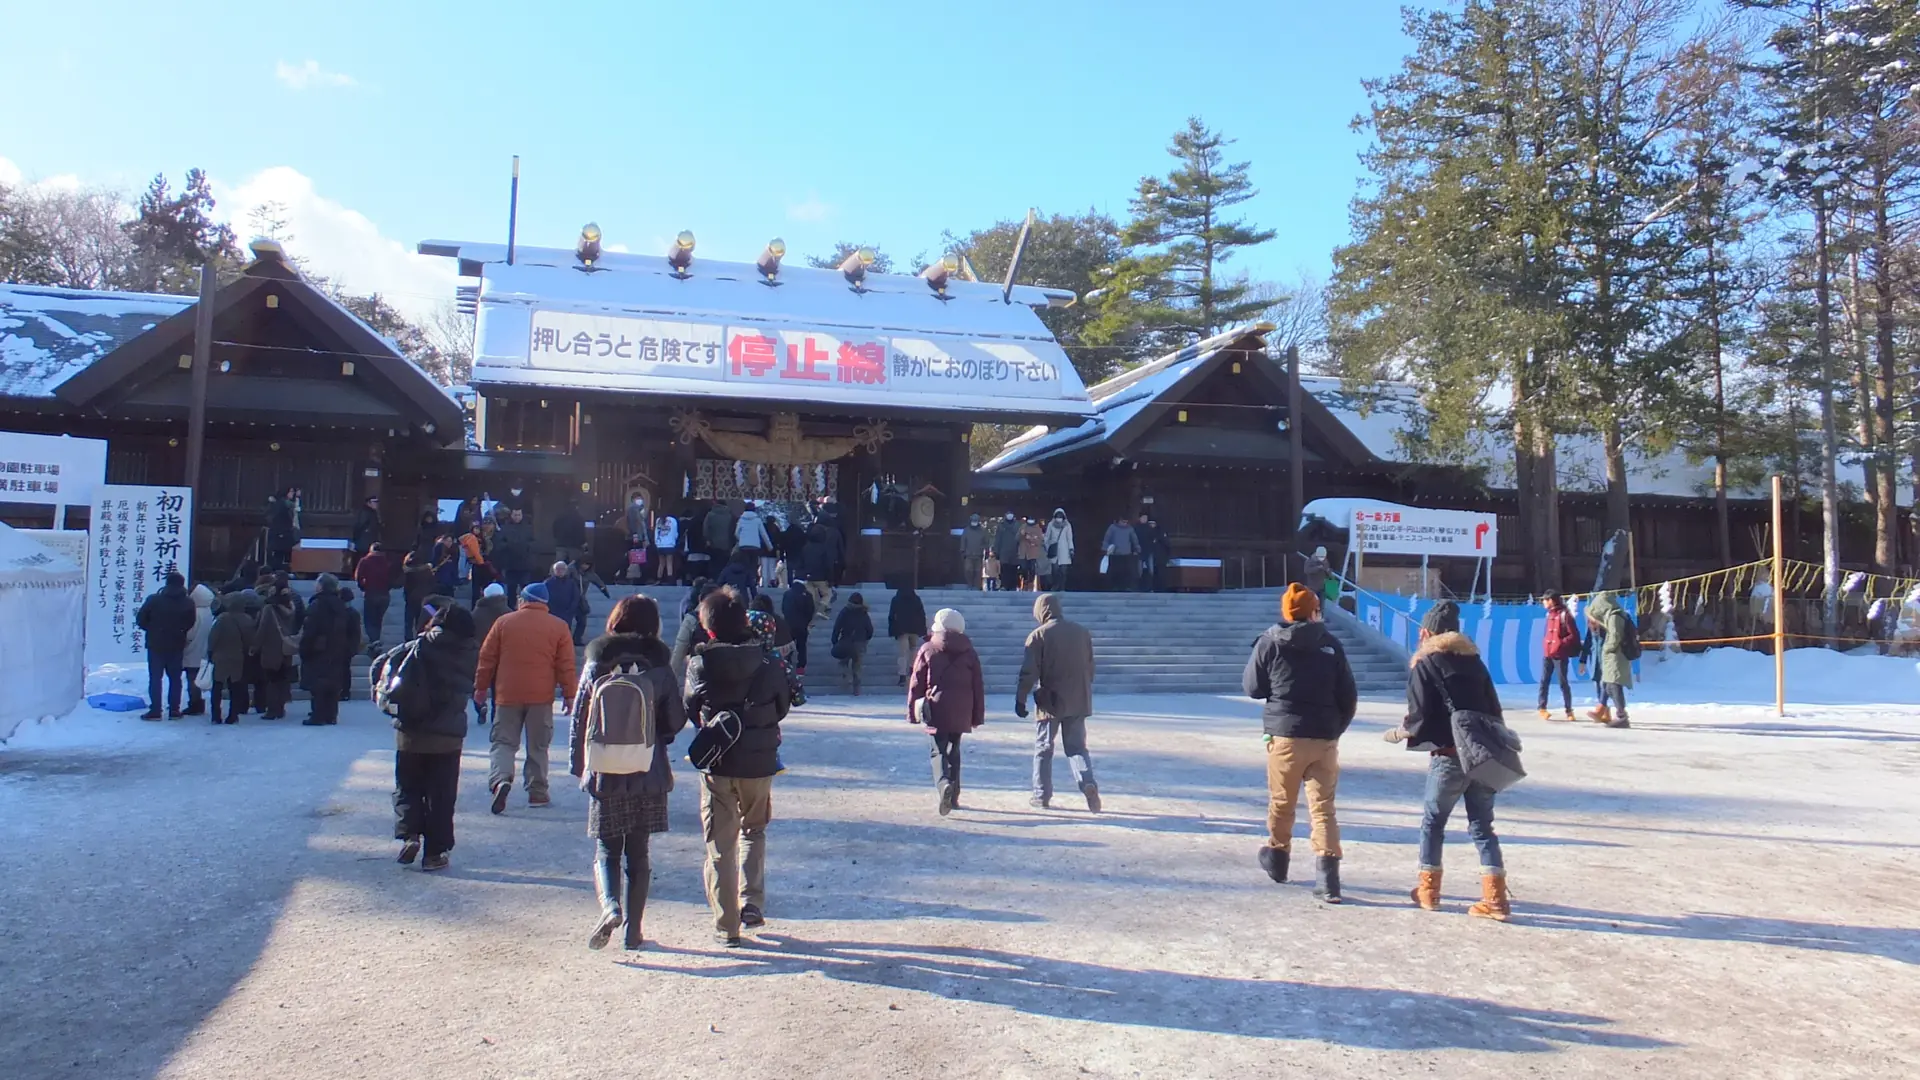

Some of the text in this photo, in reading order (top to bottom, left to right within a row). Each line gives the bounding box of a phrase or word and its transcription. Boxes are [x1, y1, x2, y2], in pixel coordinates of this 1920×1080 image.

[533, 327, 721, 364] 押し合うと 危険です
[728, 334, 886, 384] 停止線
[893, 354, 1057, 382] 静かにおのぼり下さい
[1356, 511, 1400, 522] 北一条方面
